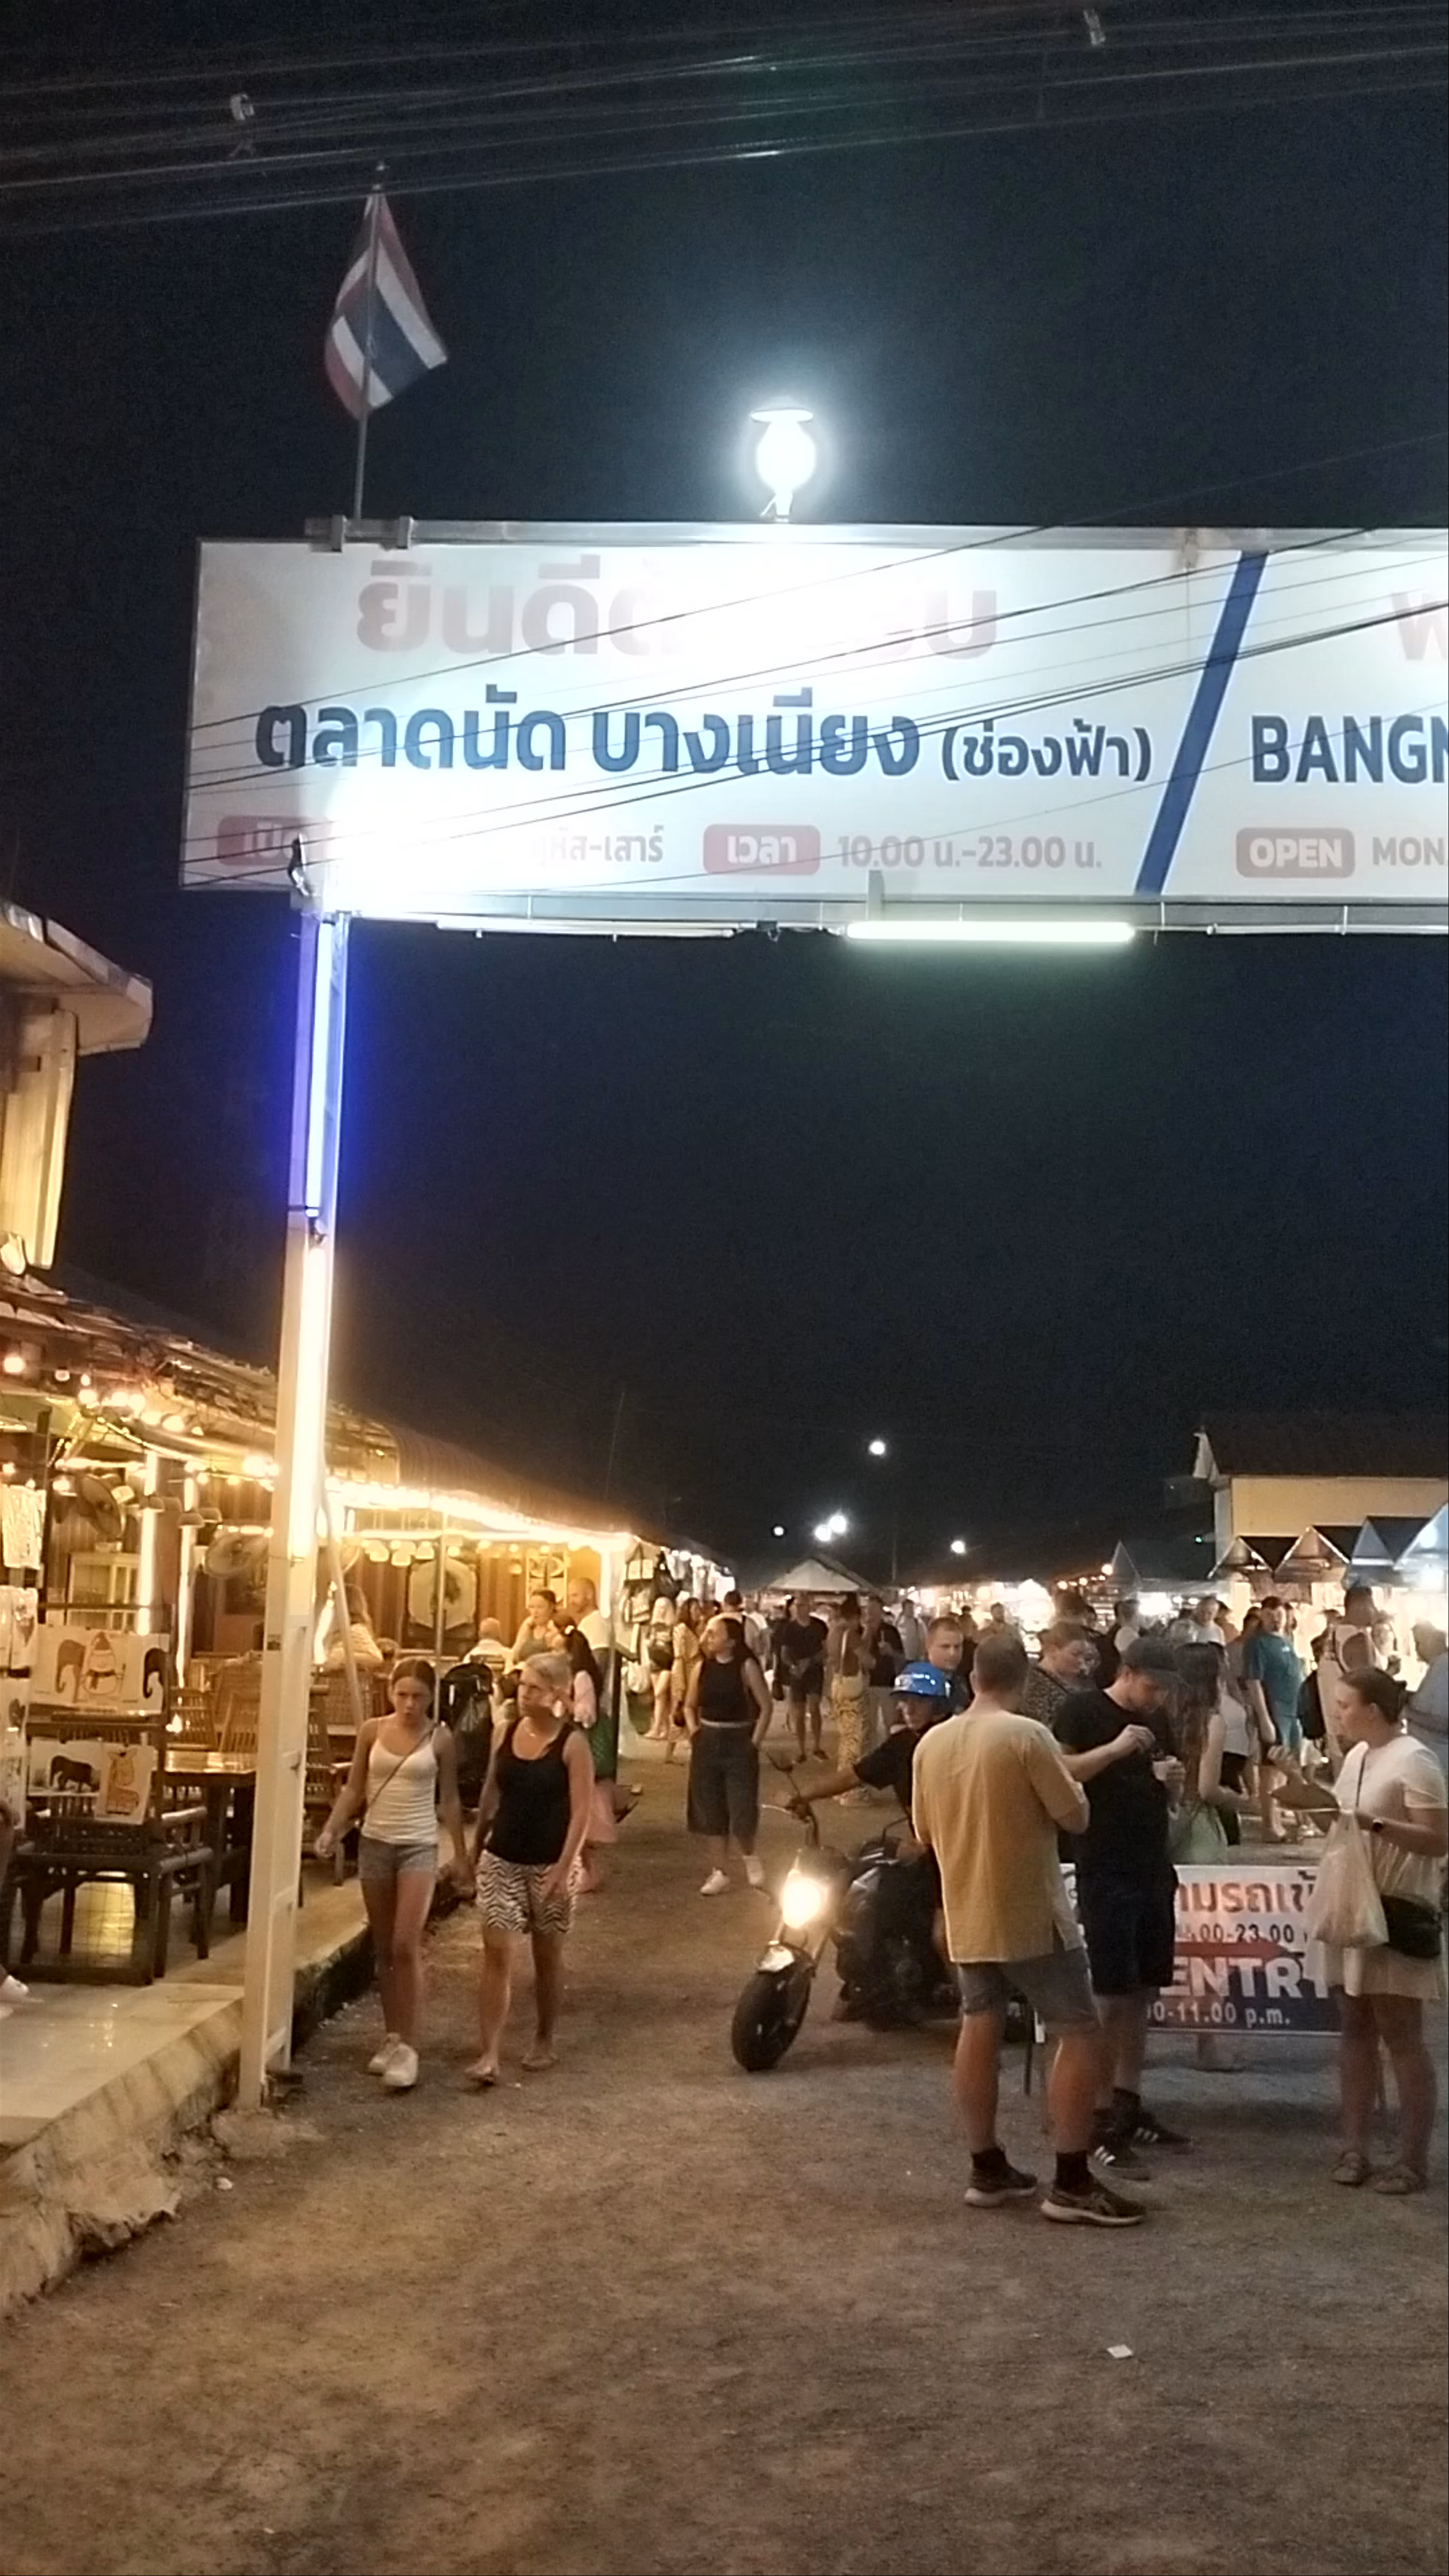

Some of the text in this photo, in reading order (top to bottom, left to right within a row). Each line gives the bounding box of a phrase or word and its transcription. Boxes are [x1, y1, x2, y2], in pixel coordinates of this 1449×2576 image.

[255, 683, 1151, 782] ตลาดนัด บางเนียง (ช่องฟ้า)
[727, 835, 797, 864] เวลา
[838, 835, 925, 867] 10.00
[1249, 838, 1342, 868] OPEN
[1246, 2007, 1290, 2028] p.m.
